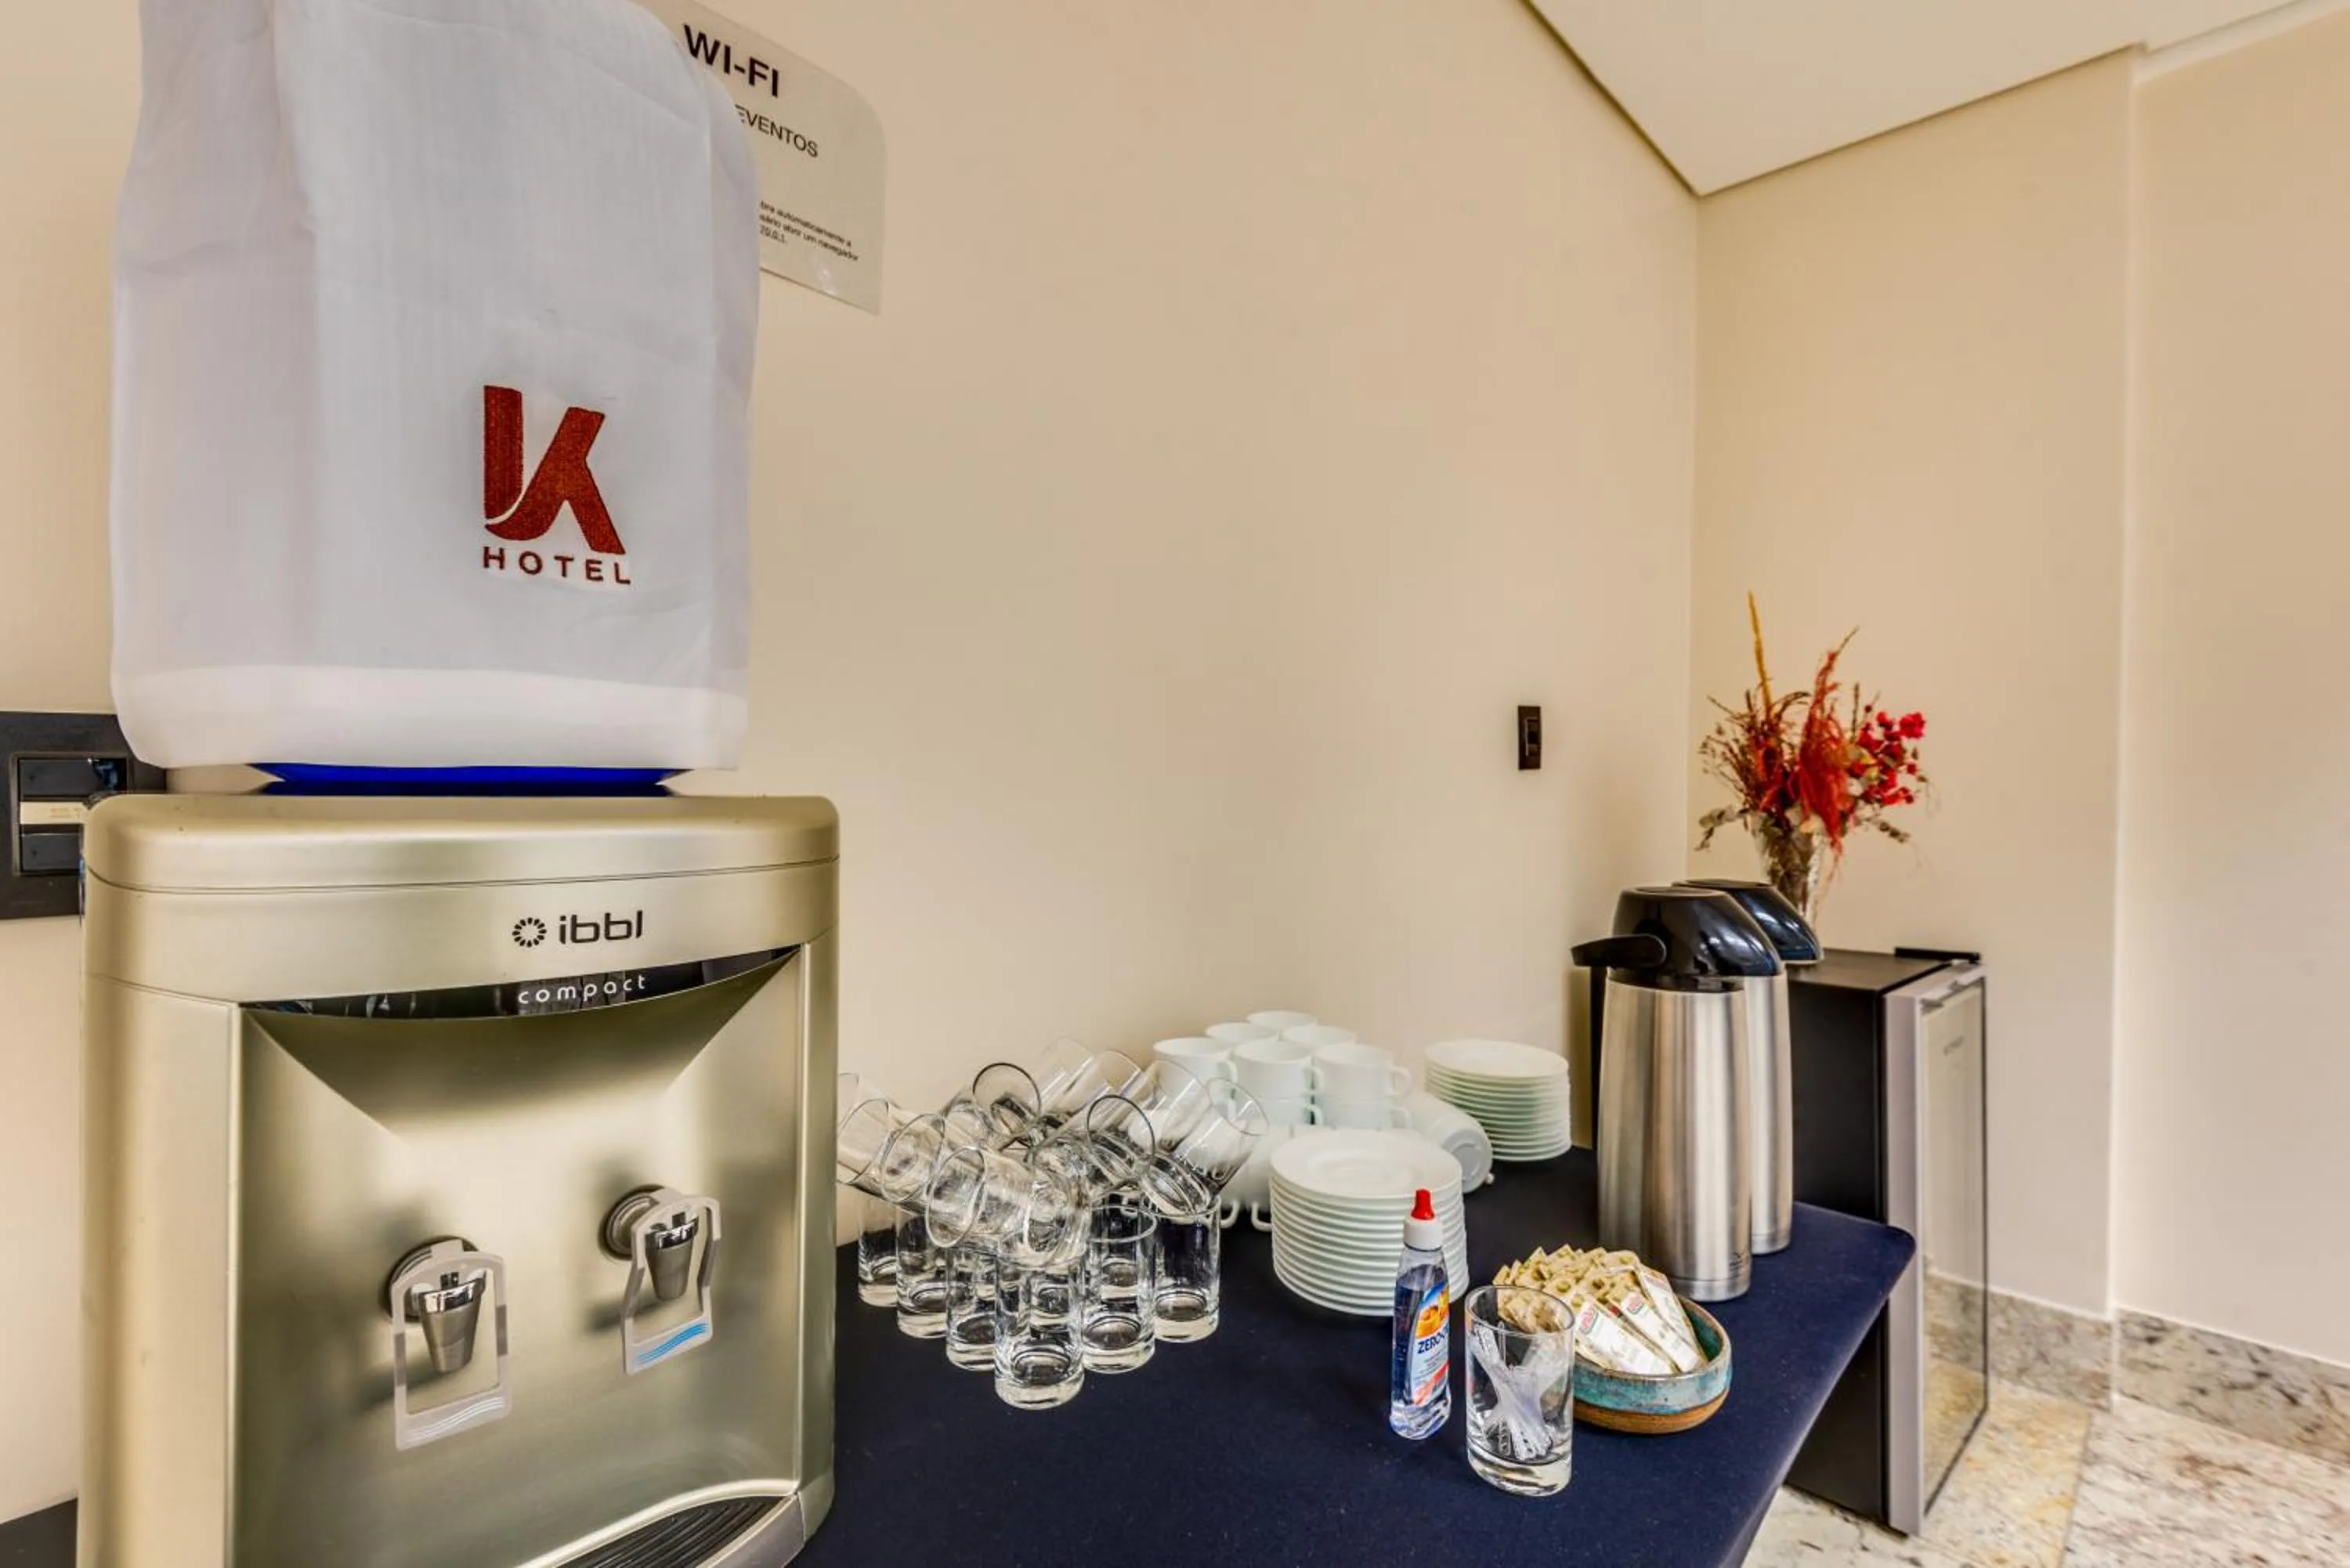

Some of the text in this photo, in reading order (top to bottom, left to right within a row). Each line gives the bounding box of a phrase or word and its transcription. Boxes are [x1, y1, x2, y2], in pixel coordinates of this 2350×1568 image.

[683, 23, 779, 98] WI-FI
[483, 546, 631, 585] HOTEL
[559, 909, 643, 945] ibbl
[517, 974, 646, 1005] compact
